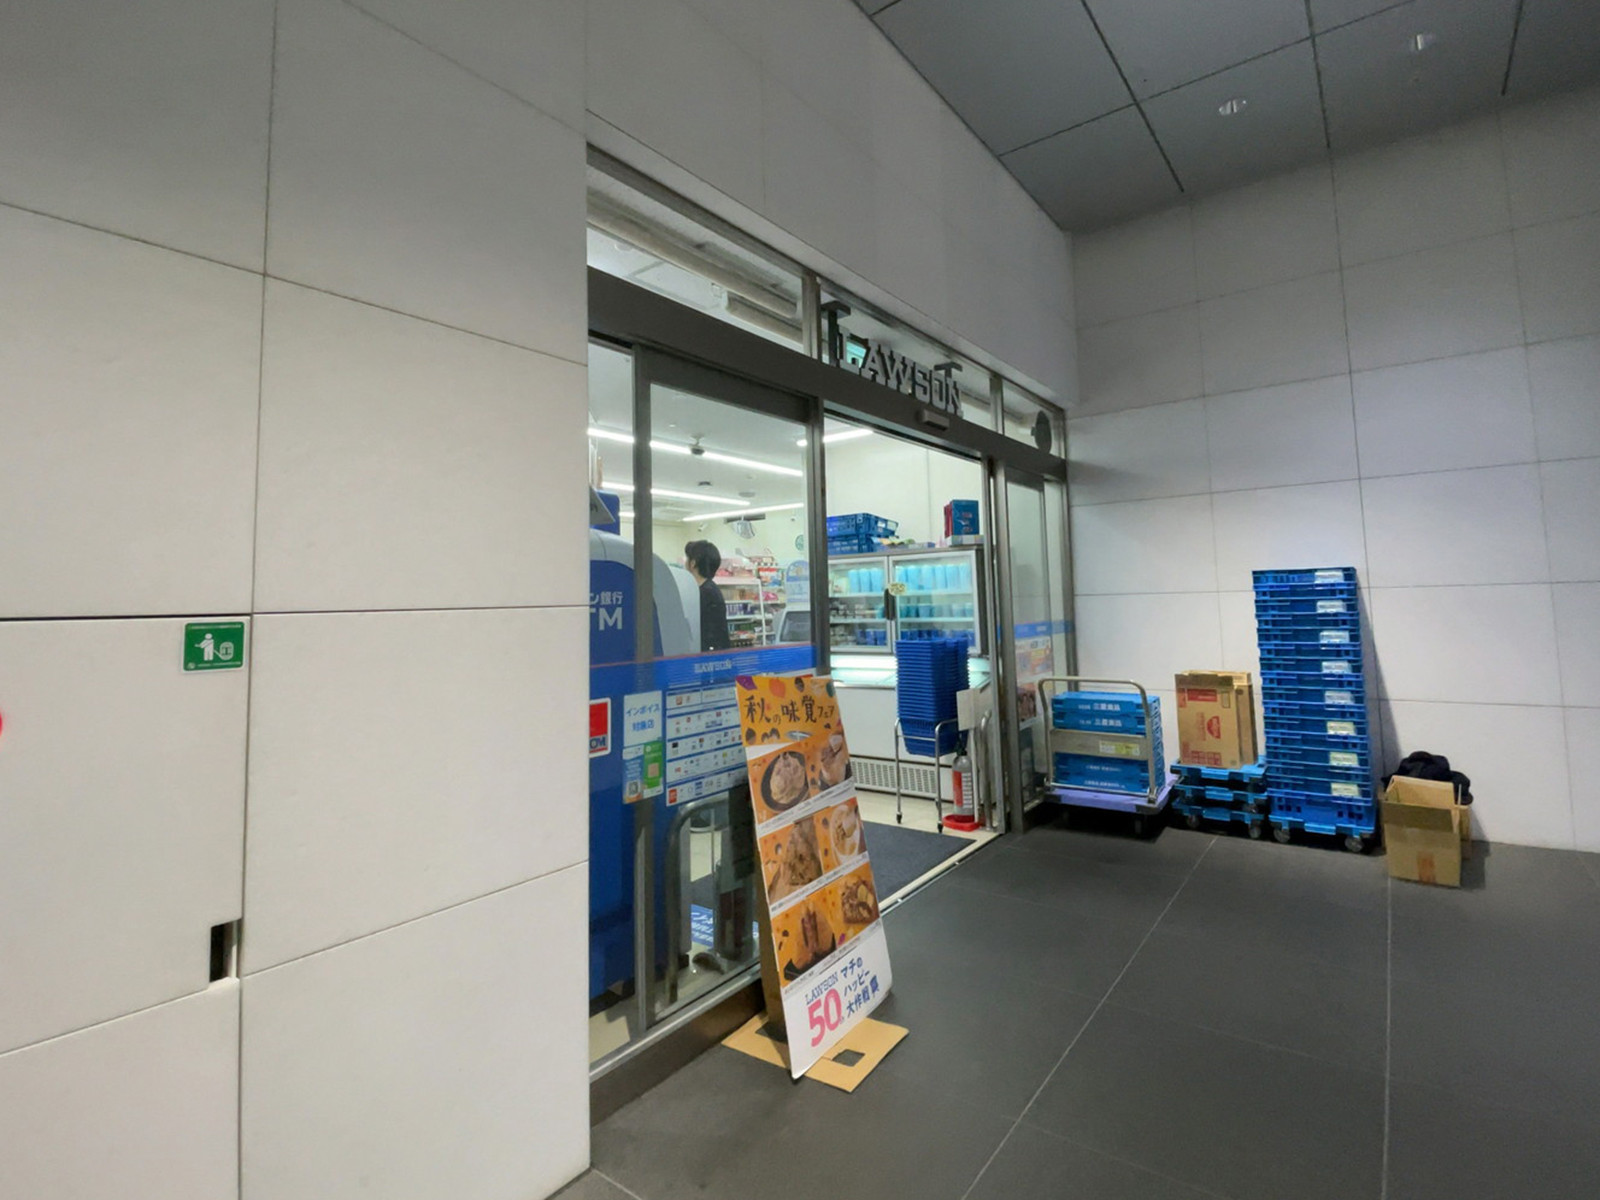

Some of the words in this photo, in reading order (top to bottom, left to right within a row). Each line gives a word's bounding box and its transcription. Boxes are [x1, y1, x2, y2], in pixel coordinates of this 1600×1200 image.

[838, 323, 963, 420] LAWSON
[744, 694, 835, 725] 秋の味覚フェア
[841, 956, 863, 979] マチの
[804, 971, 839, 1005] LAWSON
